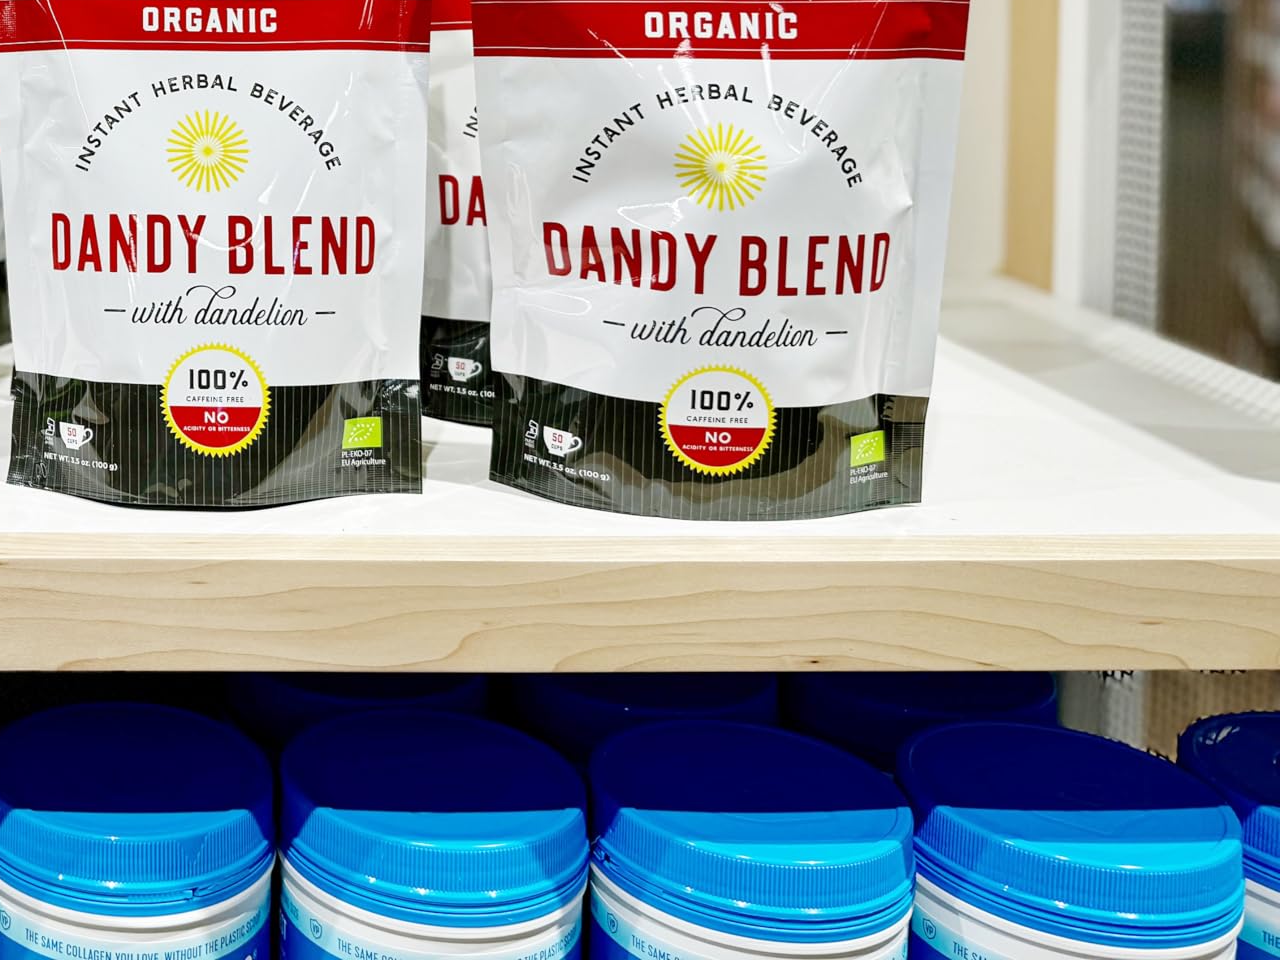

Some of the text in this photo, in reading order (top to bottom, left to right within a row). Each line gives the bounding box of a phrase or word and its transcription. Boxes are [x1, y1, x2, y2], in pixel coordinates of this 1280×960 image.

[142, 7, 277, 33] ORGANIC
[644, 11, 798, 40] ORGANIC
[75, 73, 341, 173] INSTANT HERBAL BEVERAGE
[572, 84, 862, 189] INSTANT HERBAL BEVERAGE
[51, 212, 376, 275] DANDY BLEND
[543, 221, 890, 296] DANDY BLEND
[131, 285, 308, 327] with dandelion
[631, 306, 817, 348] with dandelion
[190, 369, 248, 389] 100%
[691, 390, 753, 411] 100%
[204, 411, 229, 424] NO
[68, 428, 76, 437] 50
[552, 433, 562, 444] 50
[705, 431, 731, 444] NO
[92, 461, 108, 469] (100
[109, 463, 117, 471] g)
[351, 458, 386, 467] Agriculture
[524, 453, 537, 463] NET
[539, 458, 552, 468] WT.
[552, 462, 563, 471] 3.5
[579, 469, 599, 478] (100
[25, 927, 244, 954] THE SAME THE PLASTIC
[338, 938, 351, 954] THE
[632, 935, 646, 952] THE
[953, 941, 968, 957] THE
[1263, 931, 1280, 949] THE
